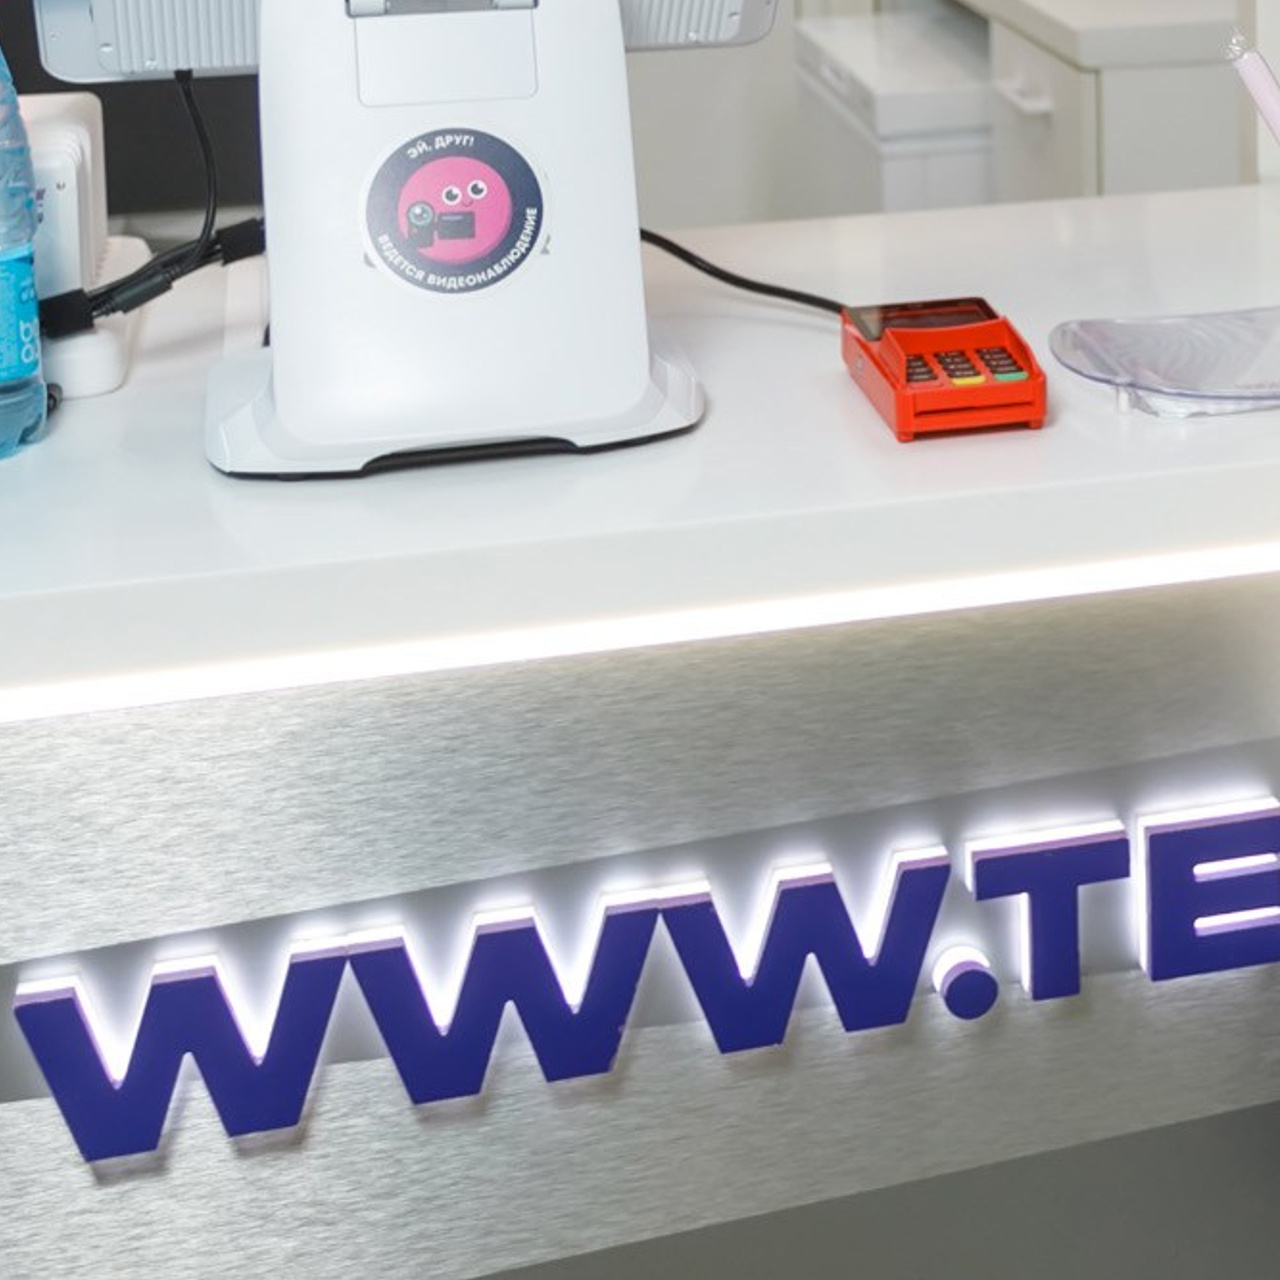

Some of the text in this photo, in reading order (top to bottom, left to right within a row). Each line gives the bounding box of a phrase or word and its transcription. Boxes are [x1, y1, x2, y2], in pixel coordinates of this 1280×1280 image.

[433, 134, 475, 150] ДРУГ!
[377, 206, 538, 290] ВЕДЕТСЯ ВИДЕОНАБЛЮДЕНИЕ
